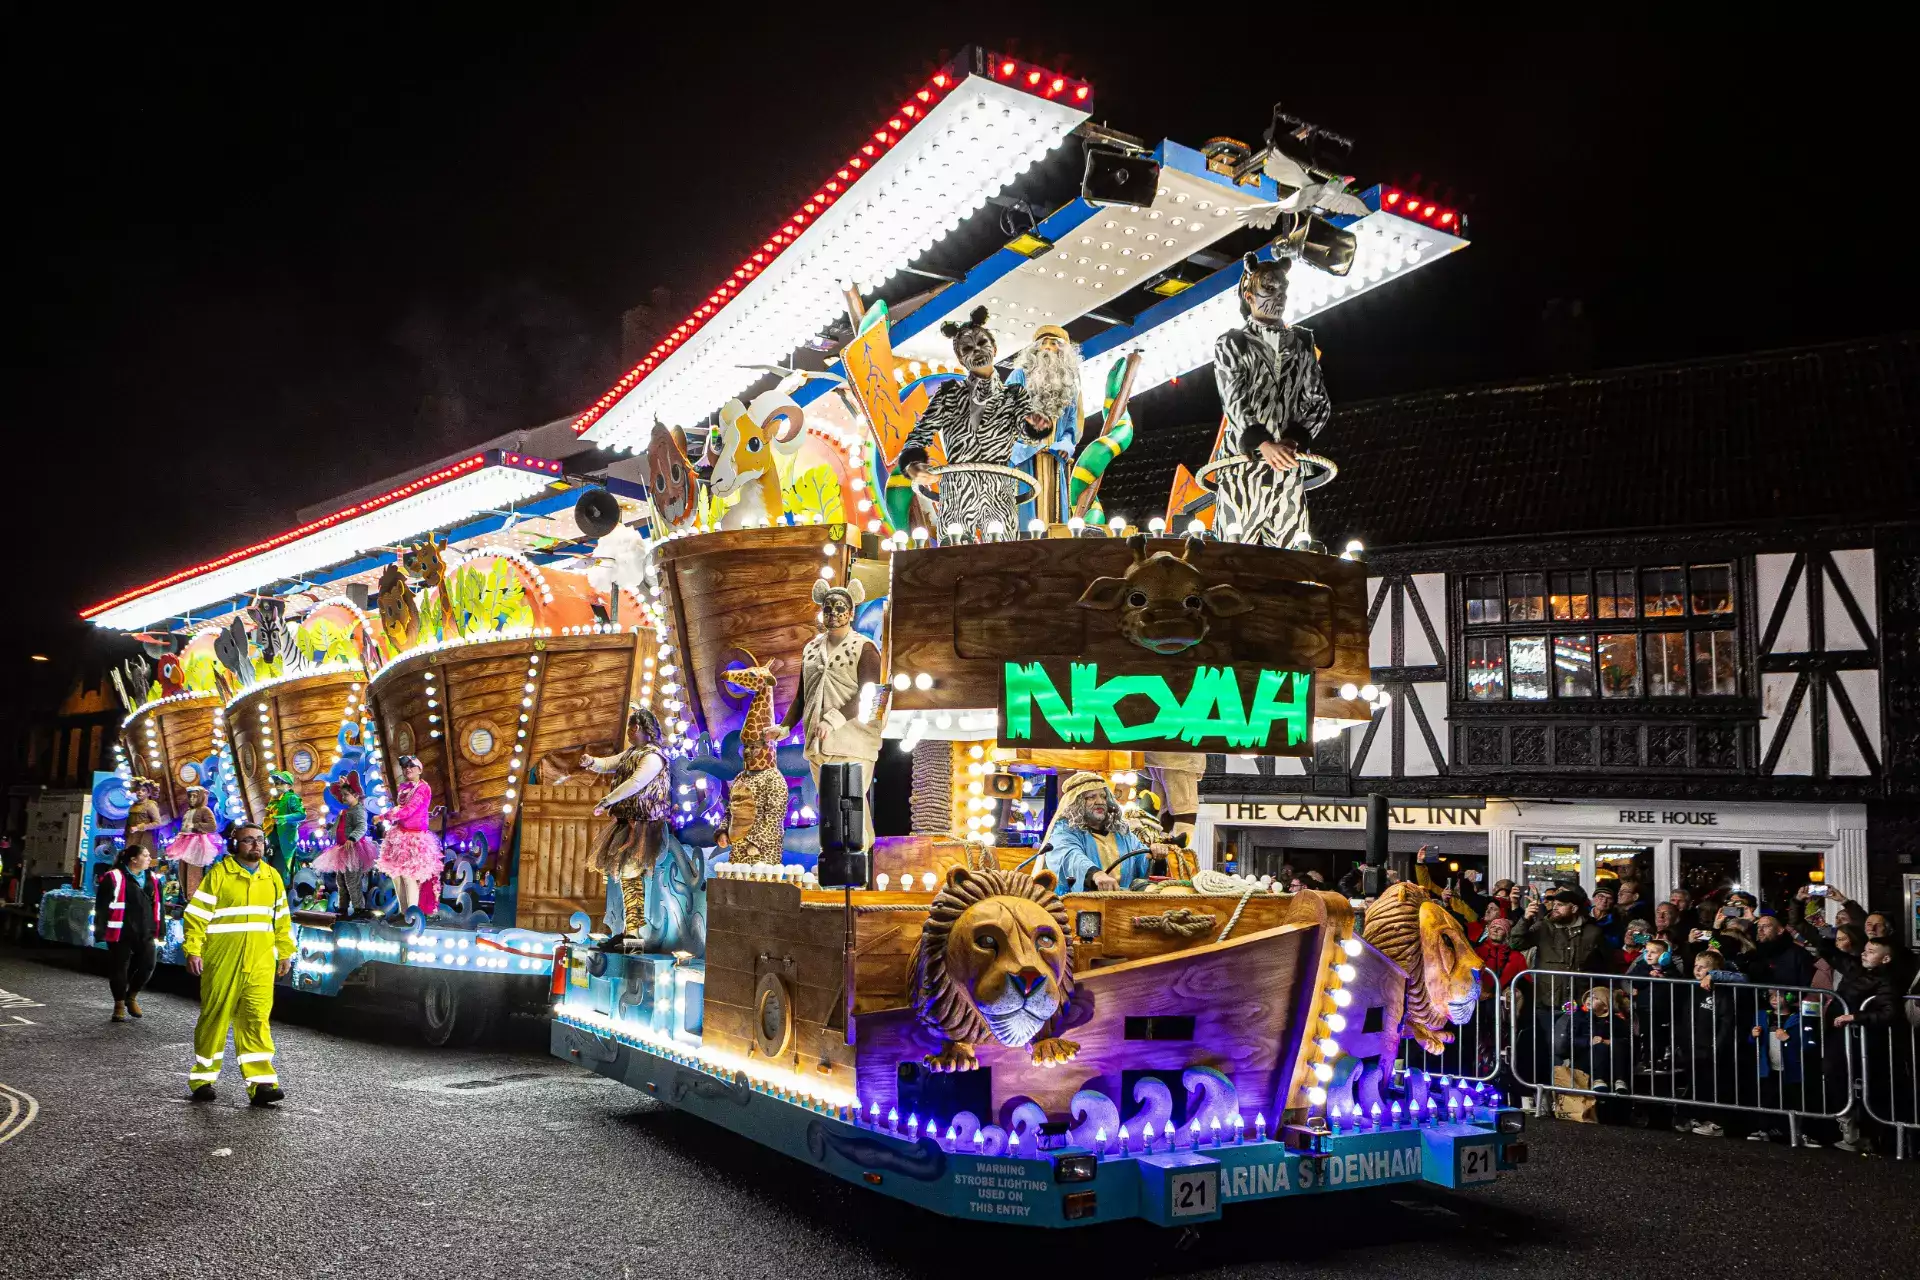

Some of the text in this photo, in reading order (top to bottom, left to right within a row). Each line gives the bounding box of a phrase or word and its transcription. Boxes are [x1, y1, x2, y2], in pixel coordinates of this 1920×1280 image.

[1005, 661, 1310, 748] NOAH
[1225, 804, 1481, 825] THE CARNIAL INN
[1619, 810, 1718, 825] FREE HOUSE
[976, 1162, 1025, 1176] WARNING
[1467, 1151, 1489, 1174] 21
[955, 1174, 1048, 1191] STROBE LIGHTING
[978, 1188, 1023, 1201] USED ON
[1180, 1180, 1206, 1208] 21
[970, 1202, 1031, 1216] THIS ENTRY
